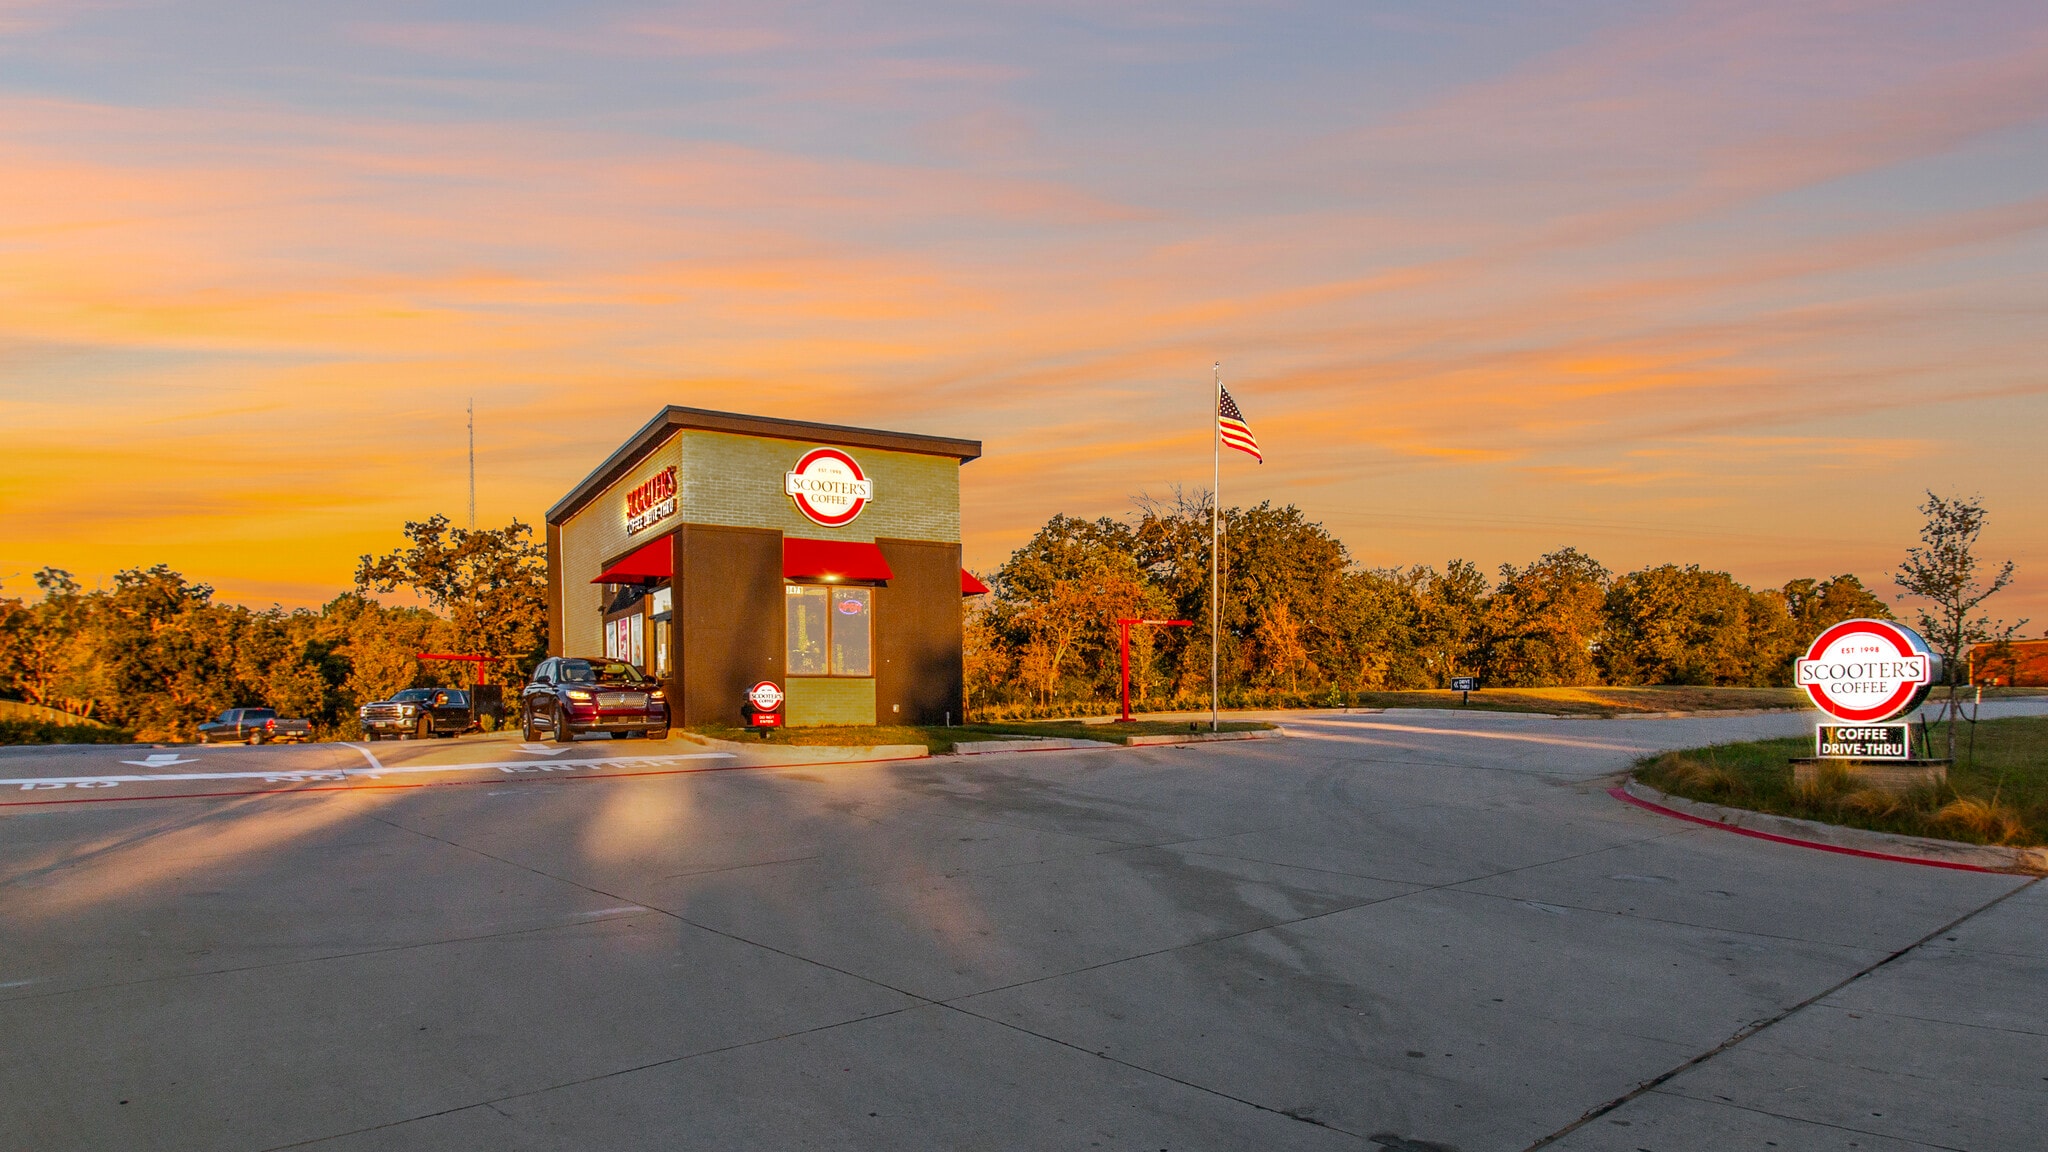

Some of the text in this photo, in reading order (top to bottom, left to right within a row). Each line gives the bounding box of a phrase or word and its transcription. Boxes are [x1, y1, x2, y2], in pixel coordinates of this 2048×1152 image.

[793, 478, 866, 495] SCOOTER'S
[811, 494, 848, 505] COFFEE
[1803, 661, 1920, 680] SCOOTER'S
[1831, 681, 1889, 694] COFFEE
[1836, 728, 1888, 740] COFFEE
[1822, 743, 1903, 755] DRIVE-THRU
